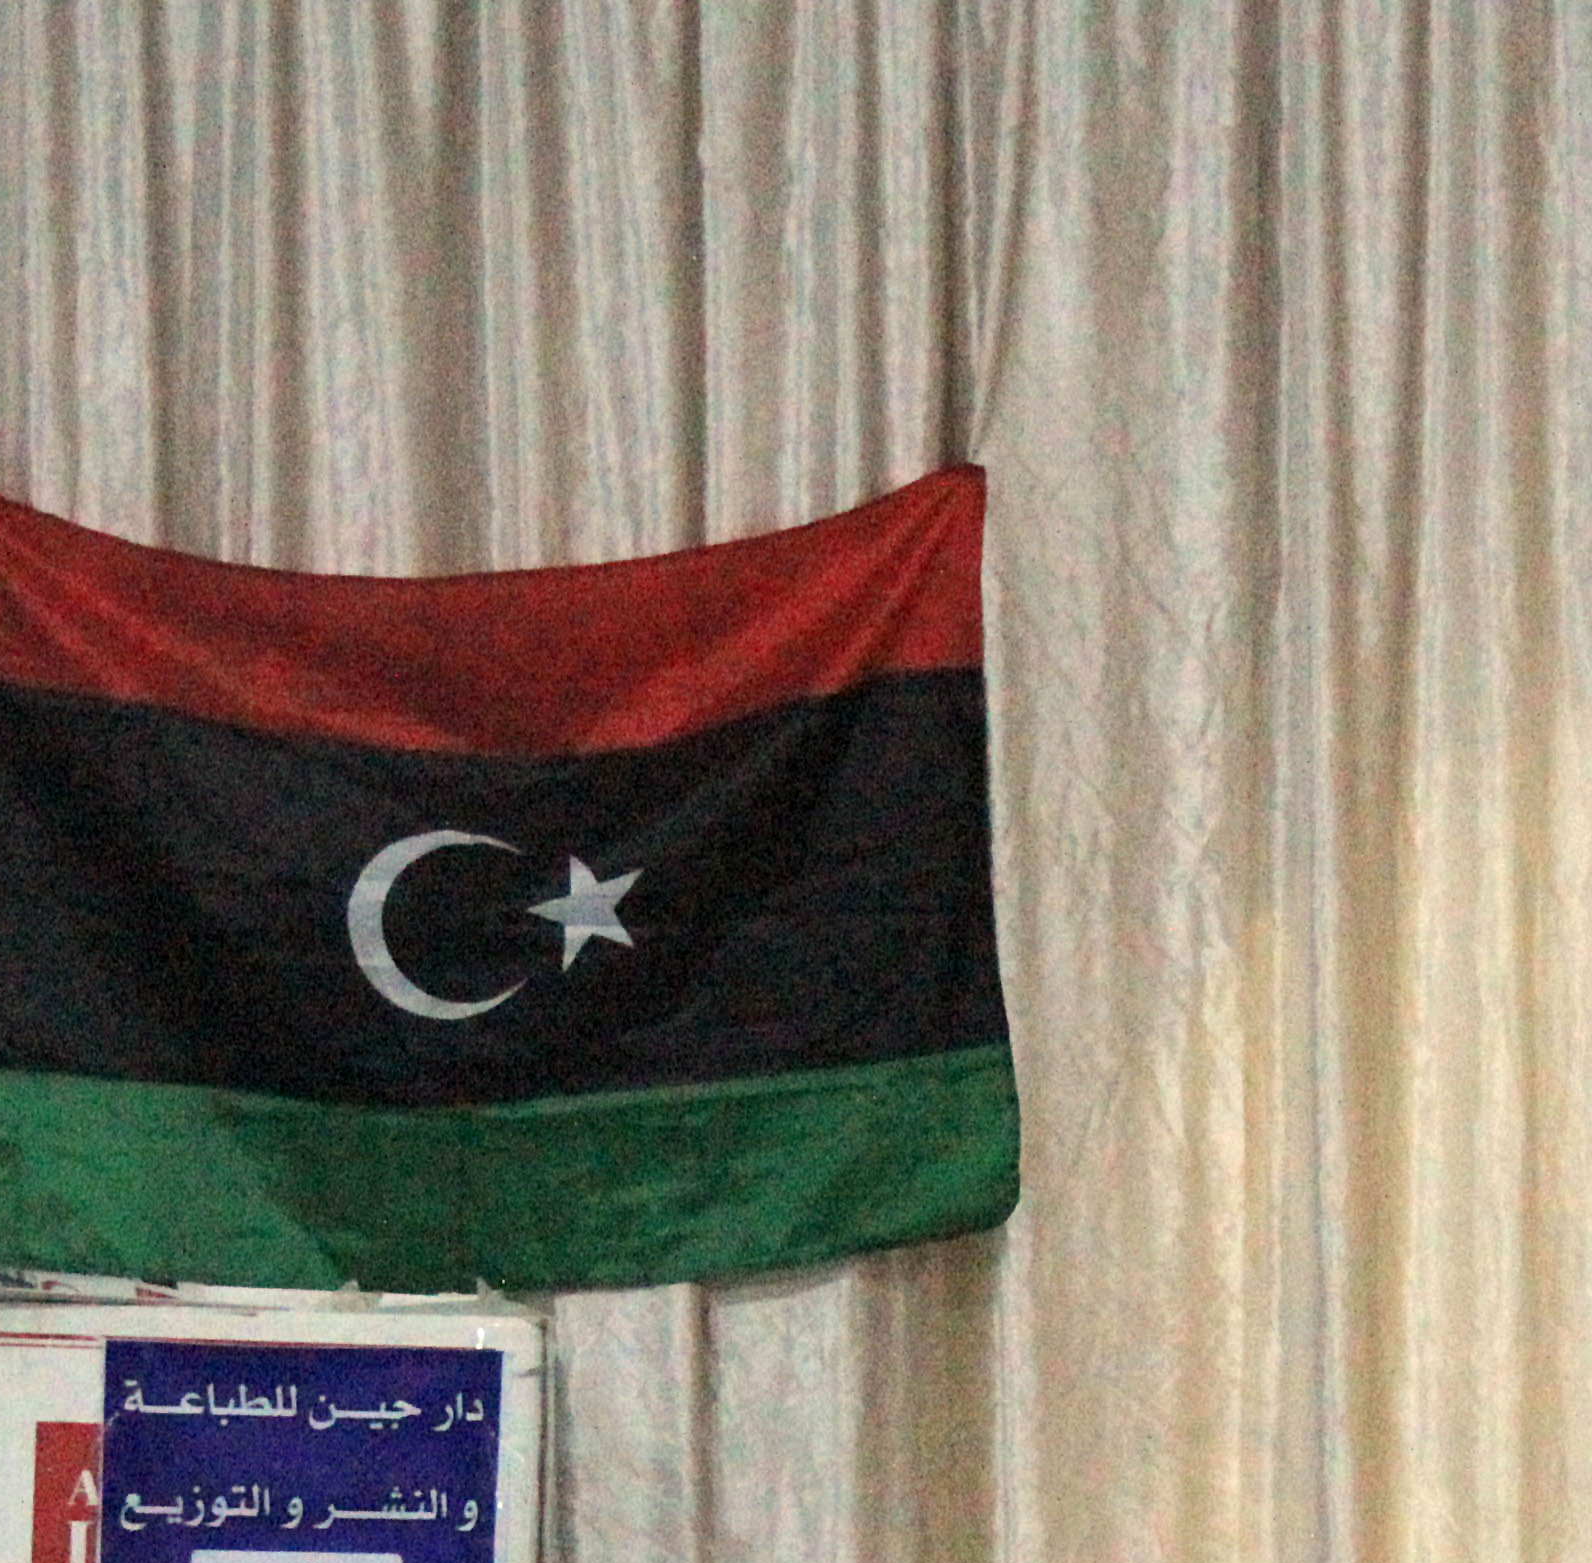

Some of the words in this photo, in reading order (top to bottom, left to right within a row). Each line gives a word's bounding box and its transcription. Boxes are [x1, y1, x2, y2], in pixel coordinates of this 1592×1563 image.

[122, 1380, 298, 1427] للطباعة
[308, 1392, 422, 1431] جين
[432, 1392, 485, 1431] دار
[119, 1484, 271, 1532] التوزيع
[281, 1495, 305, 1530] و
[313, 1486, 448, 1530] النشر
[456, 1499, 479, 1532] و
